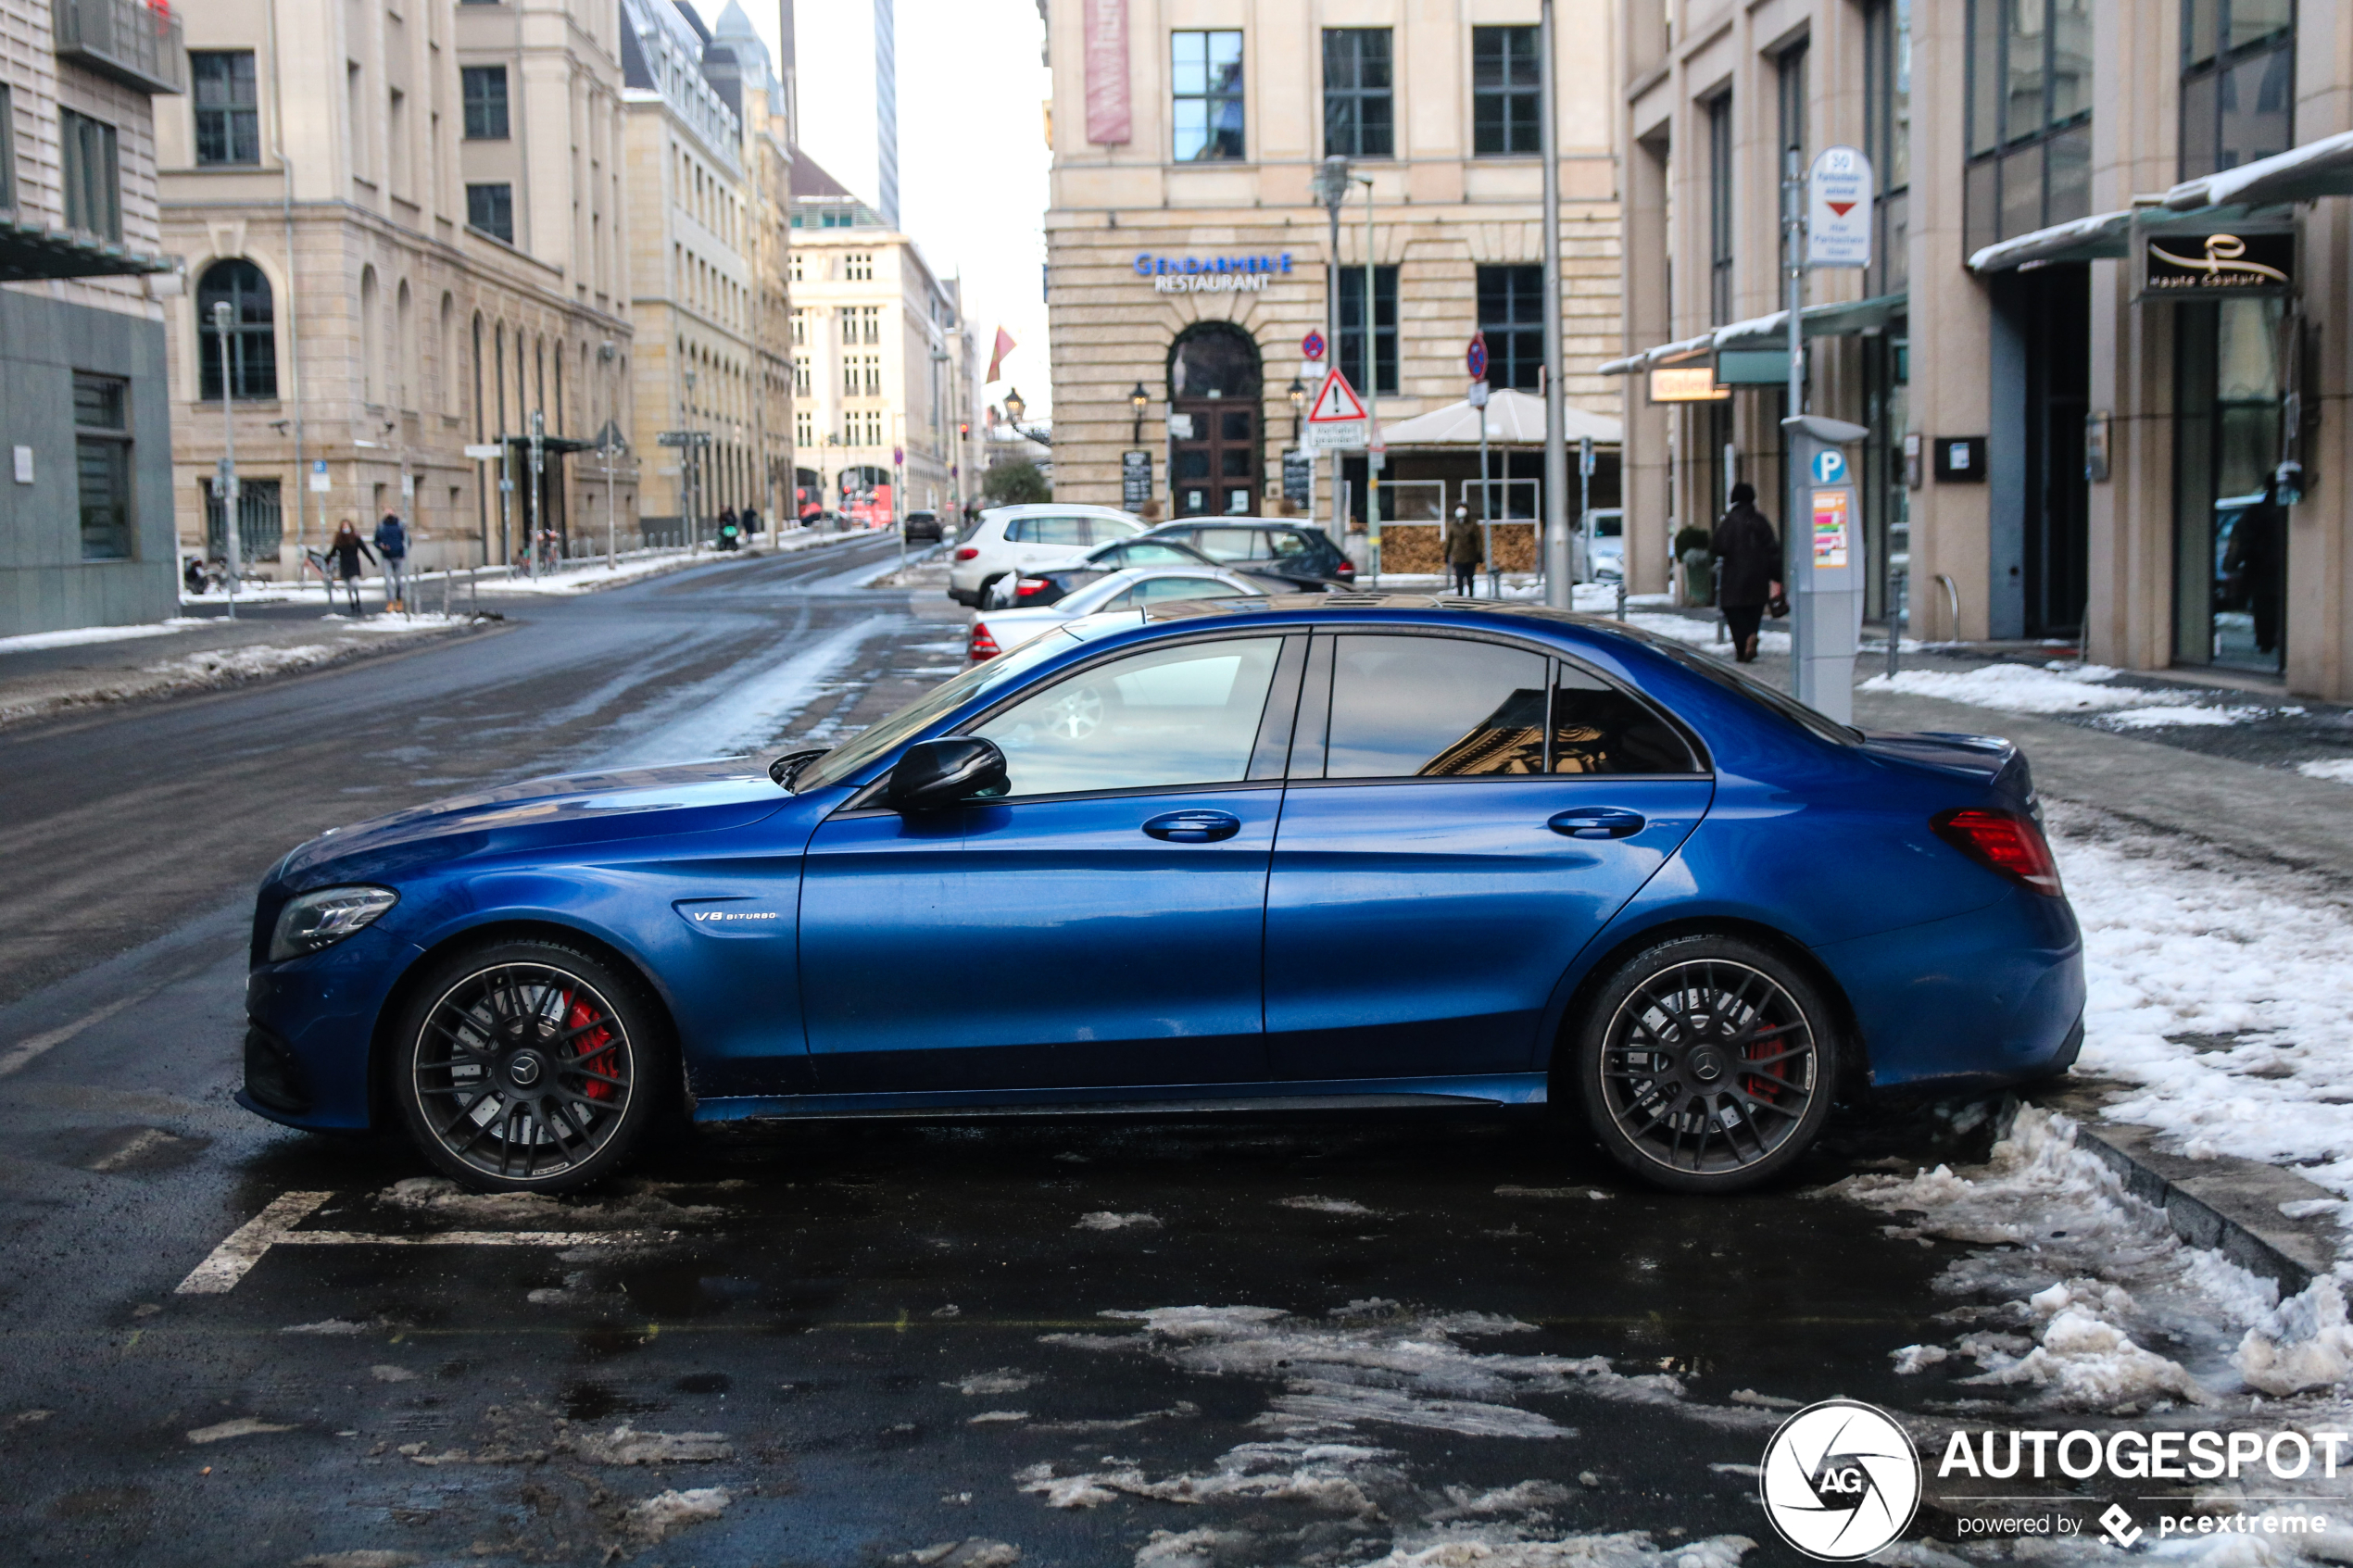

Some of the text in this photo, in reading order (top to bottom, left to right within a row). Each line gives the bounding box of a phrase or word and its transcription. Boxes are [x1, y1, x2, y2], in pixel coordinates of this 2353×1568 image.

[1154, 274, 1270, 293] RESTAURANT
[2149, 273, 2266, 288] Haute Couture
[1820, 451, 1843, 483] P
[695, 912, 723, 921] V8
